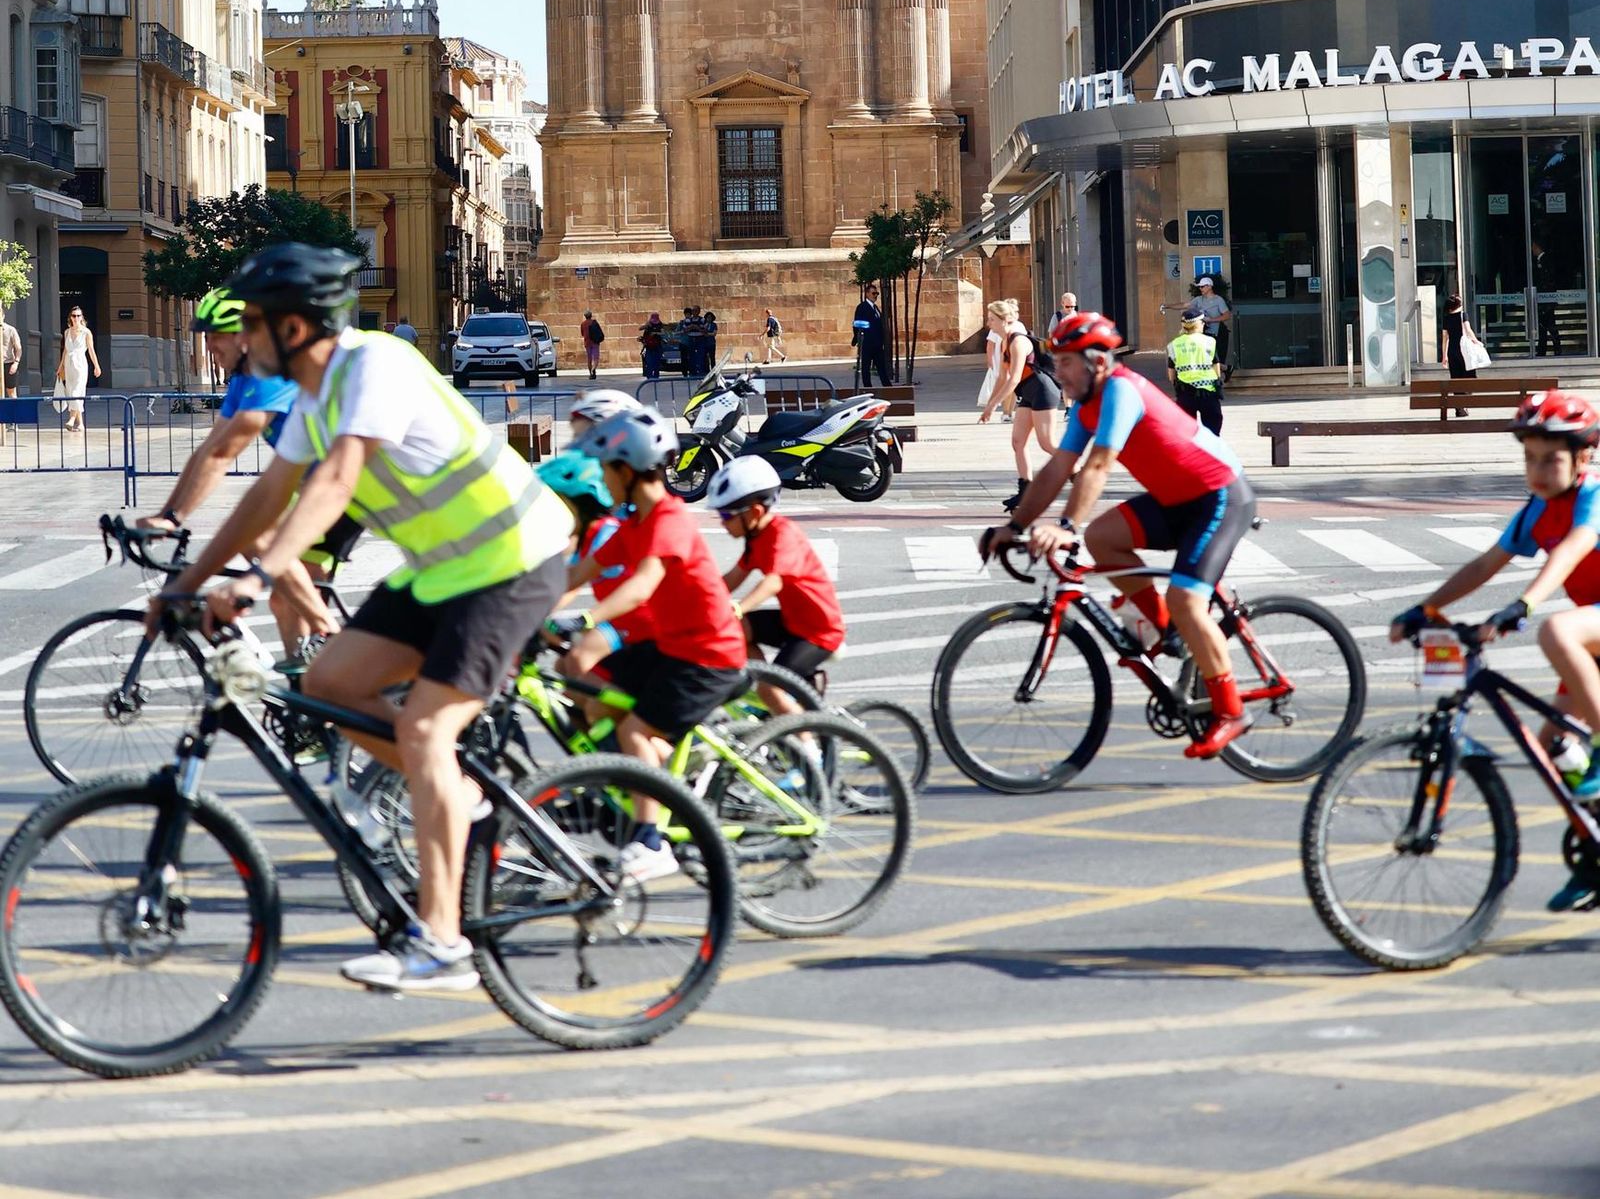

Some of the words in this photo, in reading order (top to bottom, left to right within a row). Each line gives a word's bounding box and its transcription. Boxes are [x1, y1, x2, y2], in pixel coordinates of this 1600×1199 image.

[1059, 69, 1135, 114] HOTEL
[1153, 59, 1216, 100] AC
[1242, 41, 1492, 92] MALAGA
[1527, 37, 1600, 76] PA
[1192, 214, 1220, 229] AC
[1201, 259, 1215, 275] H
